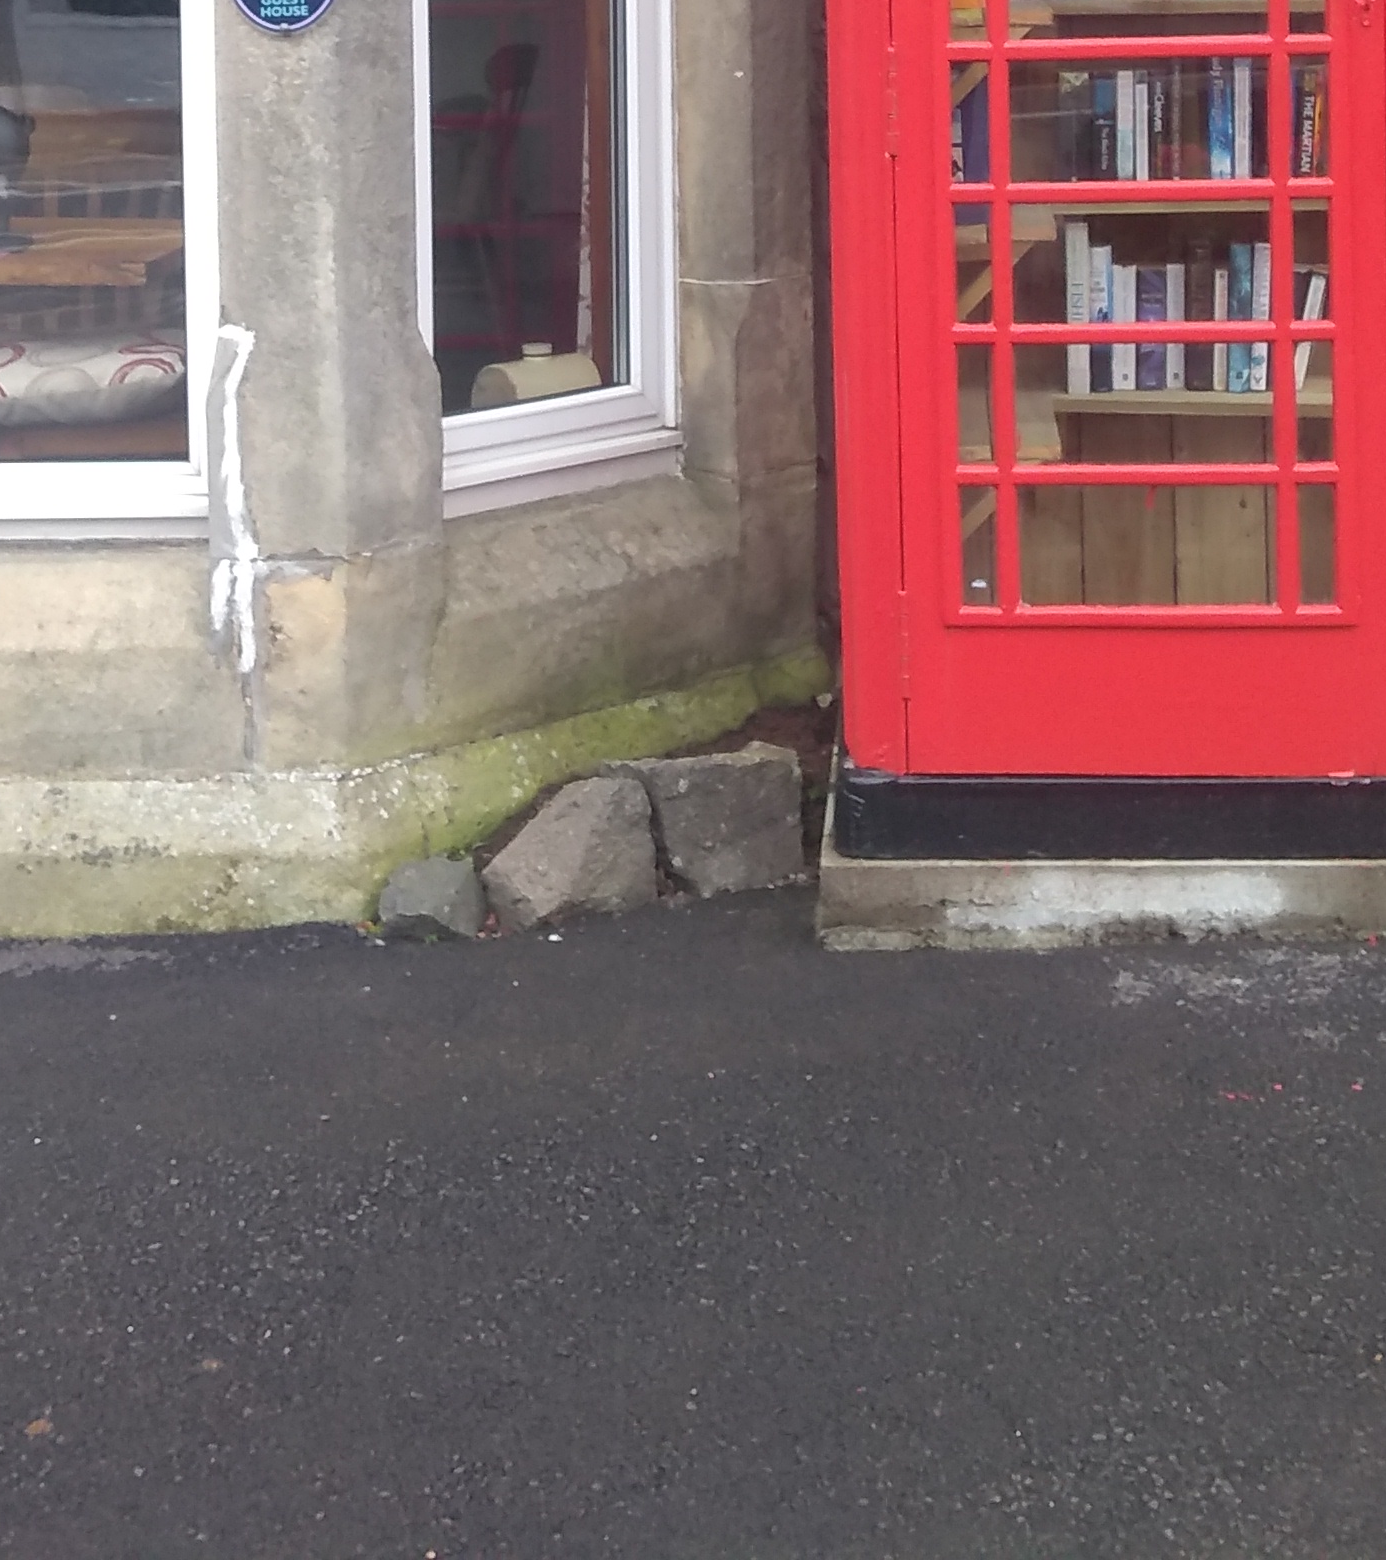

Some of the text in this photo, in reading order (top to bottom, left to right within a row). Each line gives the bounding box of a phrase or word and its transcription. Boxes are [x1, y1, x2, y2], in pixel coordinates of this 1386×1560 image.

[260, 5, 309, 17] HOUSE
[1302, 95, 1315, 119] THE
[1299, 120, 1314, 174] MARTIAN
